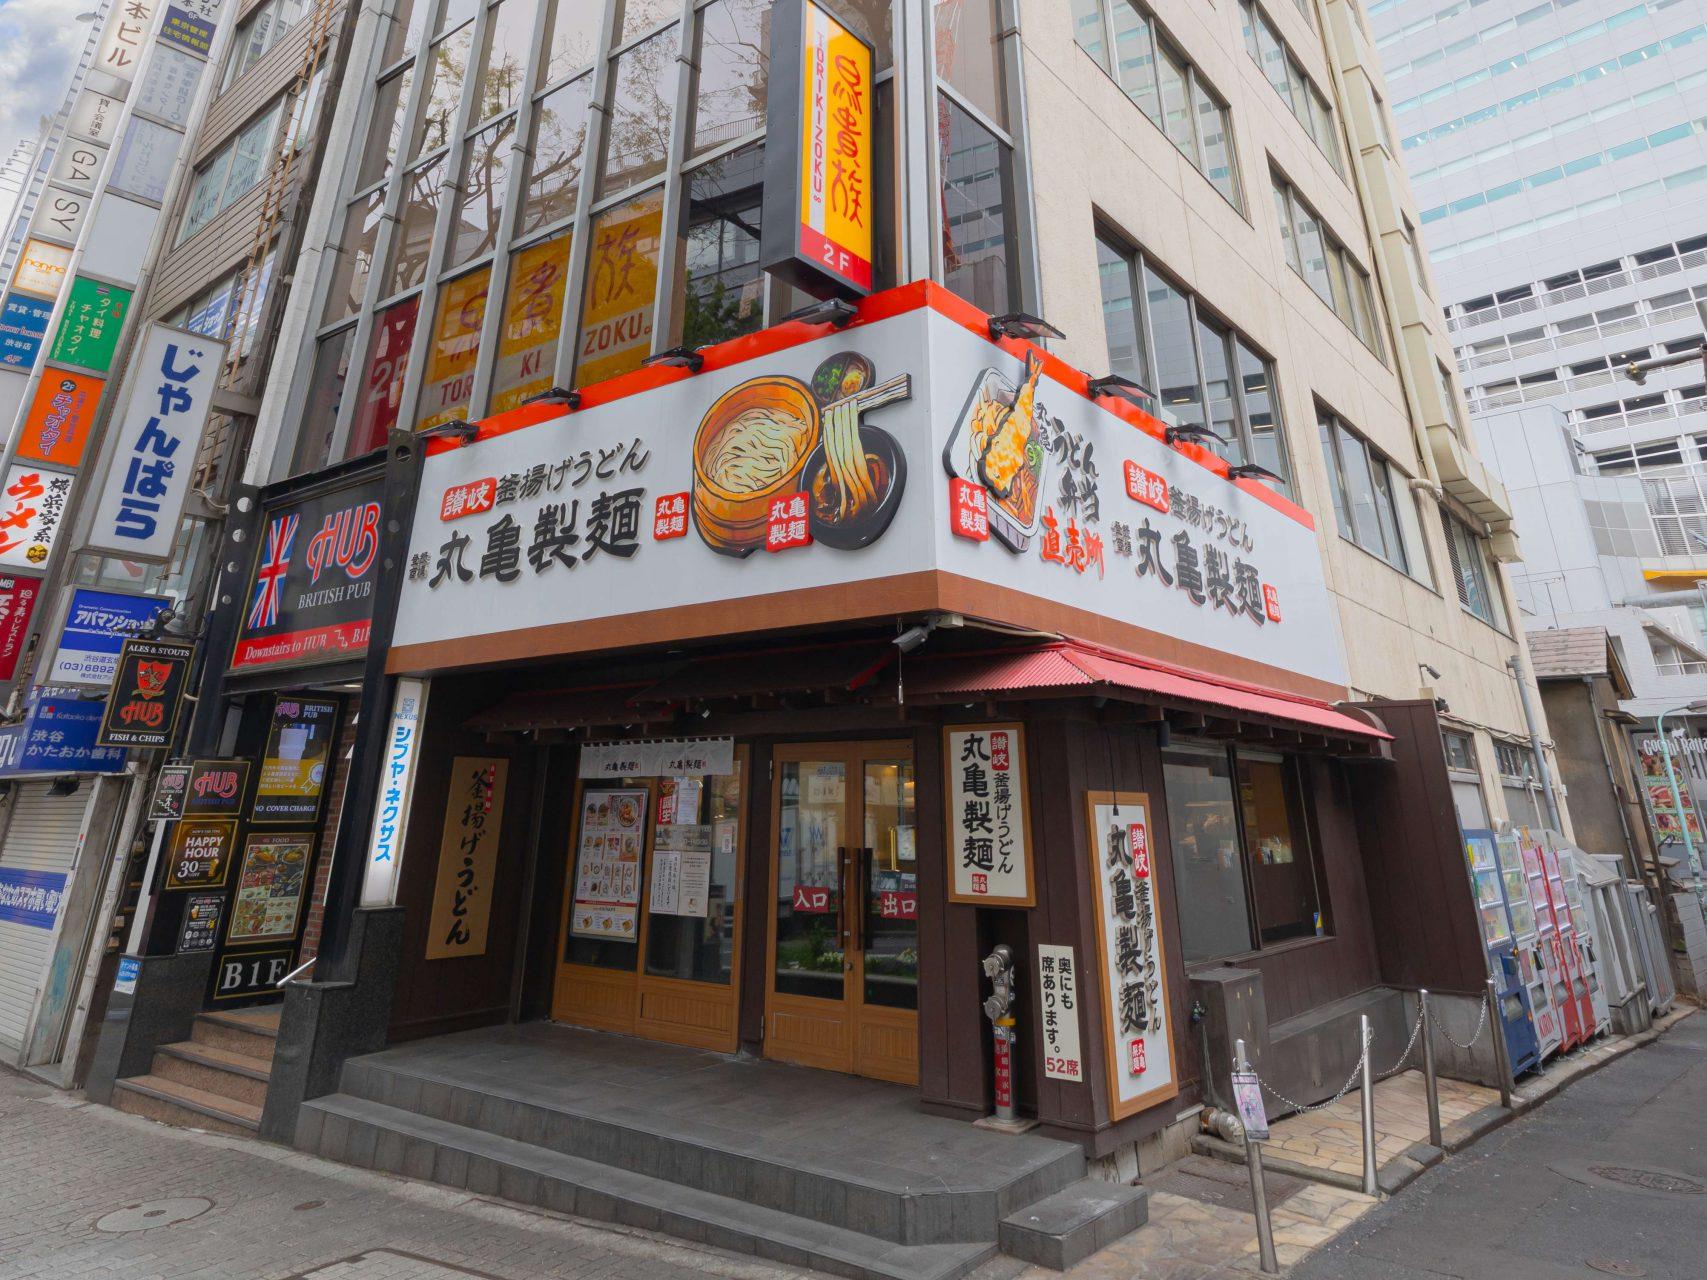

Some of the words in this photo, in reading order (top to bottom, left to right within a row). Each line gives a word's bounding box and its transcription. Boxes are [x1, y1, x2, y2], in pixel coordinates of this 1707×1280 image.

[823, 243, 850, 271] 2F
[61, 381, 75, 391] 2F
[441, 374, 473, 405] TOR
[520, 351, 542, 378] KI
[40, 393, 73, 456] チャオタイ
[114, 344, 204, 540] じゃんぱら
[495, 437, 650, 506] 釜揚げうどん
[1130, 465, 1167, 508] 讃岐
[33, 478, 70, 543] 横浜家系
[443, 482, 491, 517] 讃岐
[1169, 486, 1253, 554] 釜揚げうどん
[306, 501, 381, 586] HUB
[428, 488, 648, 589] 丸亀製麺
[1041, 506, 1104, 579] 直売所
[1136, 517, 1265, 626] 丸亀製麺
[298, 586, 345, 610] BRITISH
[347, 581, 371, 600] PUB
[128, 645, 149, 653] ALES
[158, 648, 190, 657] STOUTS
[245, 641, 290, 660] Downstairs
[292, 641, 301, 652] to
[303, 634, 327, 651] HUB
[120, 701, 165, 727] HUB
[304, 705, 333, 713] BRITISH
[394, 713, 418, 721] NEXUS
[26, 744, 122, 760] かたおか歯科
[31, 730, 64, 742] 渋谷
[109, 733, 129, 742] FISH
[138, 735, 165, 743] CHIPS
[992, 736, 1008, 766] 讃岐
[194, 771, 238, 798] HUB
[375, 726, 411, 862] シブヤ・ネクサス
[961, 733, 994, 871] 丸亀製麺
[994, 772, 1013, 874] 釜揚げうどん
[185, 837, 224, 847] HAPPY
[185, 848, 219, 858] HOUR
[445, 771, 491, 946] 釜揚げうどん
[1132, 829, 1148, 873] 讃岐
[178, 861, 199, 878] 30
[794, 889, 827, 908] 入口
[884, 894, 916, 916] 出口
[1107, 825, 1148, 1034] 丸亀製麺
[1135, 880, 1161, 1032] 釜揚げうどん
[221, 959, 287, 989] B1F
[1058, 957, 1073, 1009] 奥にも
[1041, 956, 1060, 1053] 席あります。
[1045, 1058, 1078, 1076] 52席
